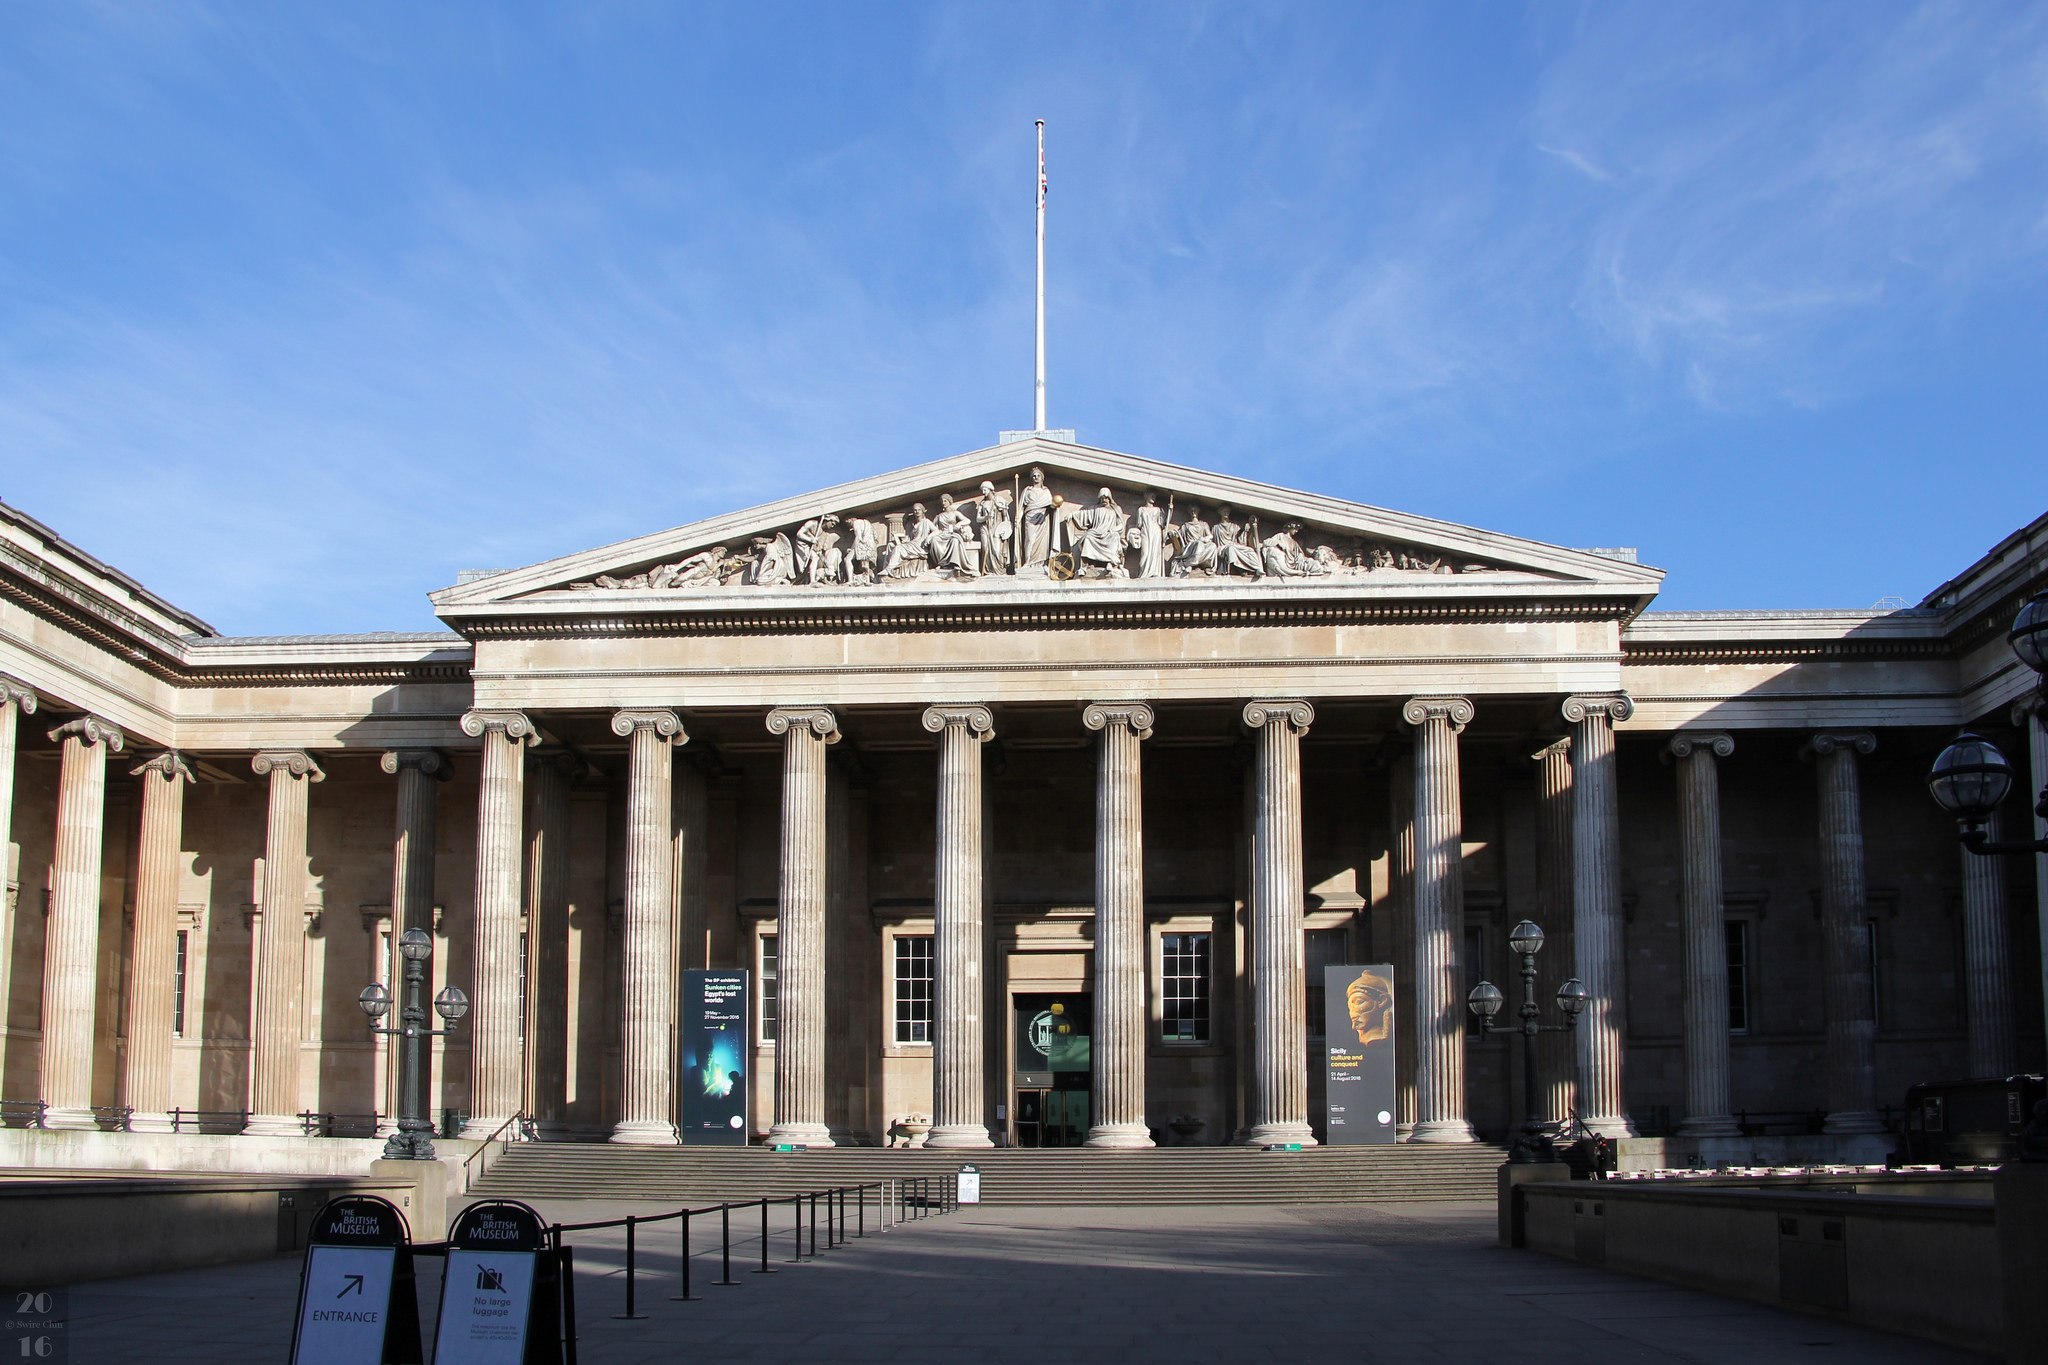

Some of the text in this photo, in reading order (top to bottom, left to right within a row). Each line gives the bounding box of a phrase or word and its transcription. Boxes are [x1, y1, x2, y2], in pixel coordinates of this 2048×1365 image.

[340, 1208, 355, 1216] THE
[479, 1213, 494, 1221] THE
[343, 1216, 378, 1225] BRITISH
[482, 1220, 517, 1230] BRITISH
[330, 1222, 380, 1235] MUSEUM
[469, 1227, 519, 1240] MUSEUM
[474, 1296, 511, 1307] No large
[313, 1310, 378, 1323] ENTRANCE
[472, 1306, 509, 1317] luggage
